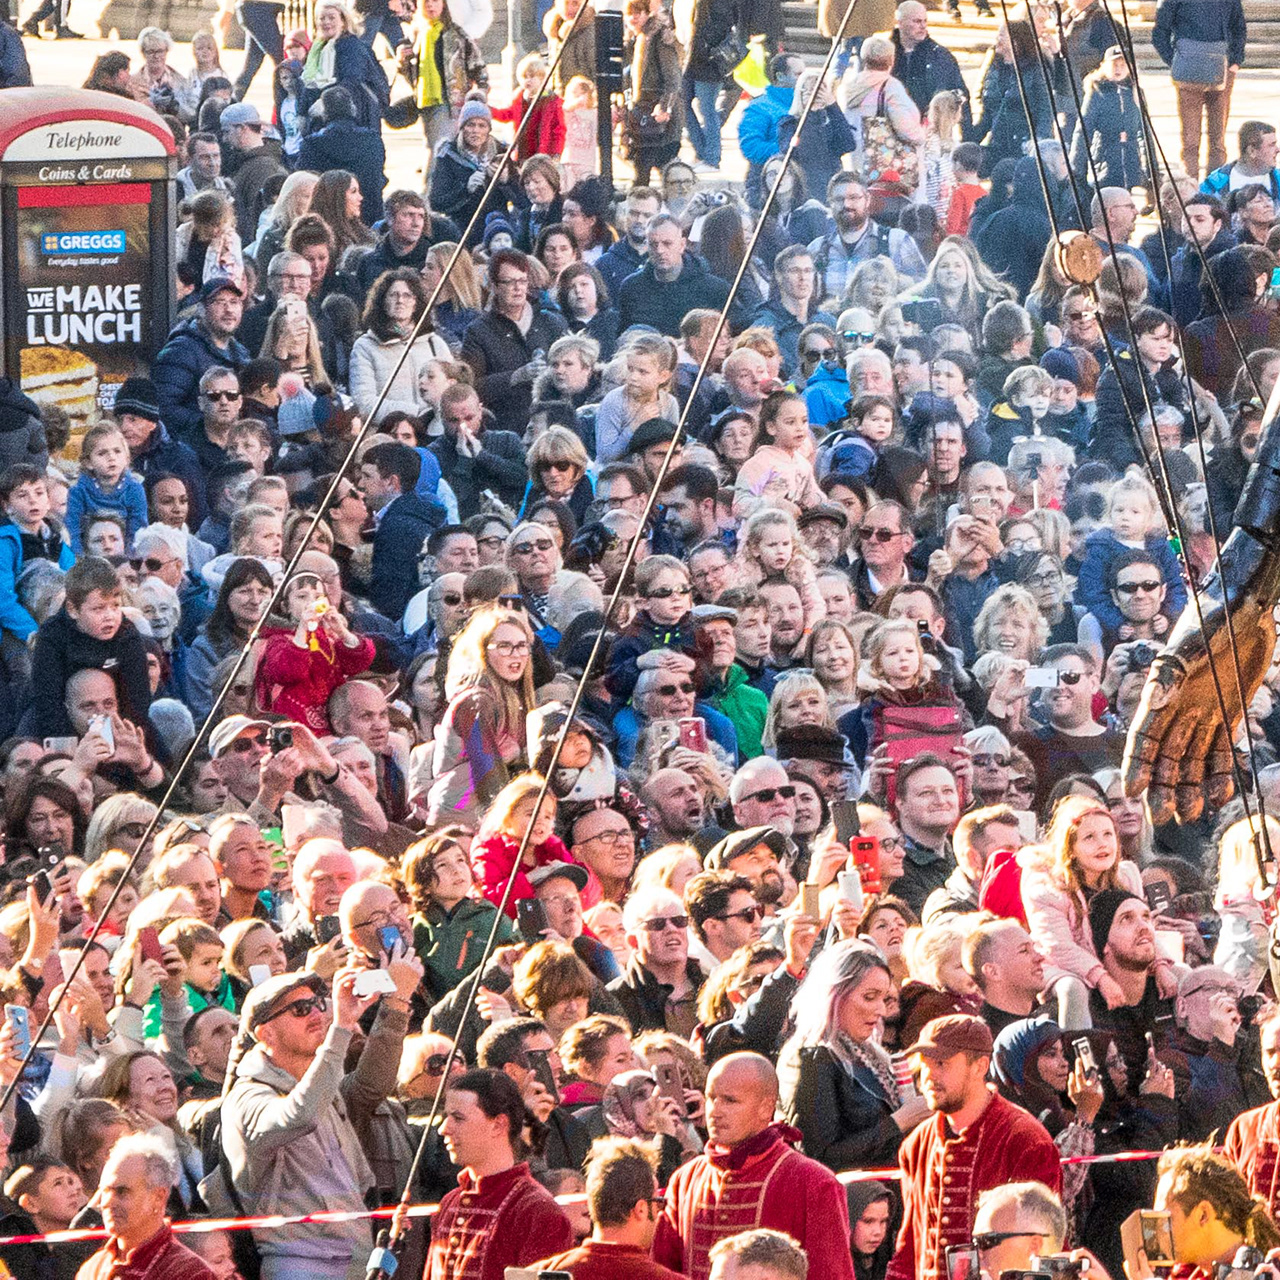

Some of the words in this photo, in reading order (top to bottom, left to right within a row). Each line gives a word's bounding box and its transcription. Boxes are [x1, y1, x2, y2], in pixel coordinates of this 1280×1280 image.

[46, 132, 122, 151] Telephone
[39, 166, 76, 181] Coins
[77, 165, 90, 180] &
[93, 164, 132, 180] Cards
[60, 234, 121, 250] GREGGS
[48, 258, 78, 267] Everyday
[101, 256, 119, 266] good
[27, 293, 54, 308] WE
[56, 284, 141, 312] MAKE
[27, 312, 141, 344] LUNCH
